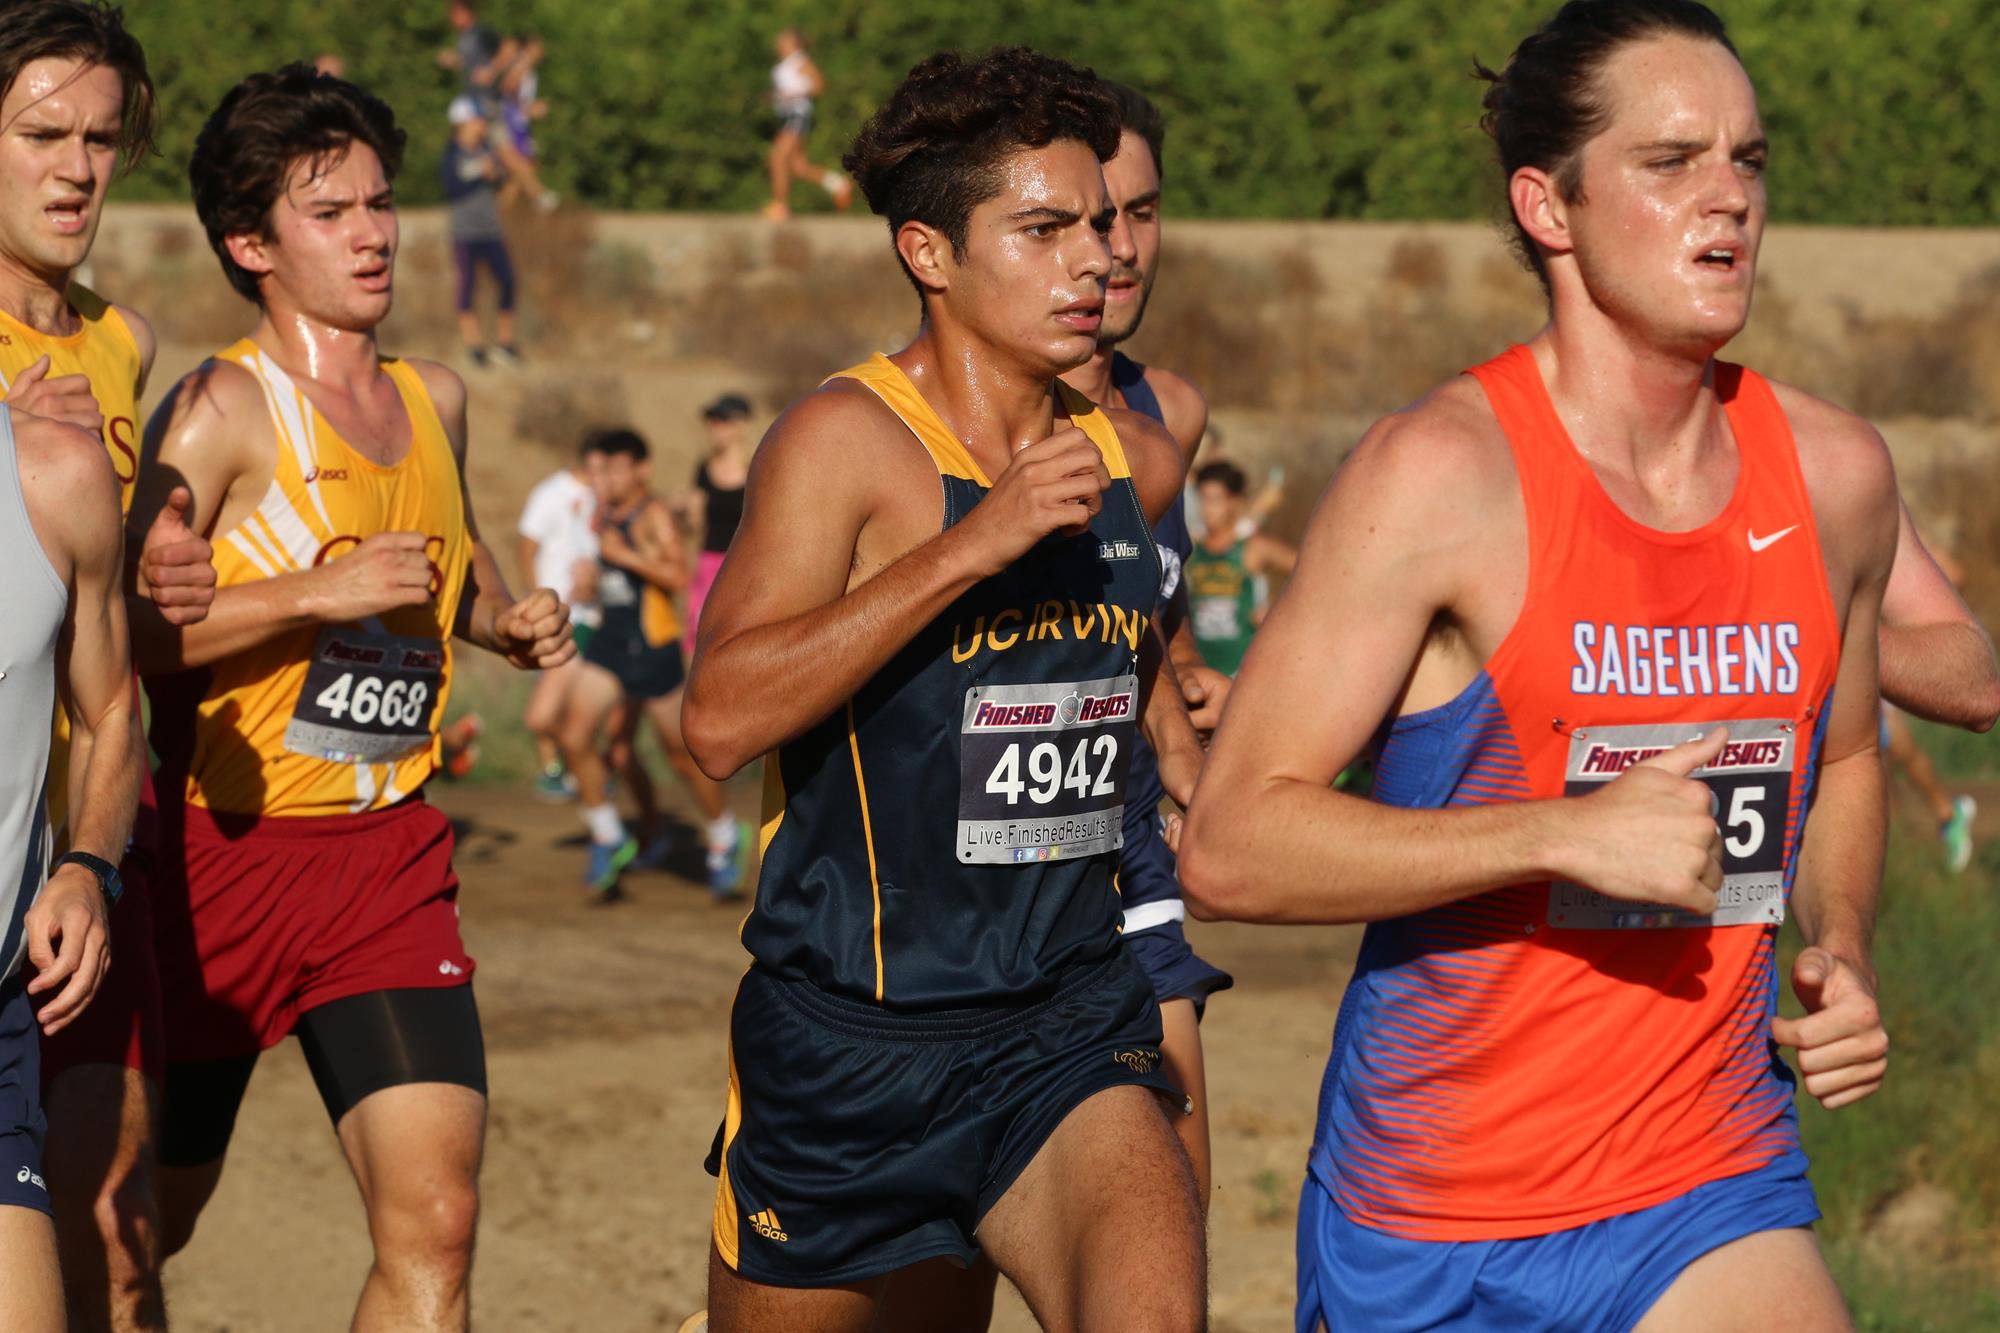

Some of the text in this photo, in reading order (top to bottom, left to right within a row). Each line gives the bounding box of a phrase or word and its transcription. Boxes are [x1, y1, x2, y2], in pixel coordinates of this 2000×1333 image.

[320, 469, 348, 481] asics
[1099, 543, 1138, 559] BIG WEST
[952, 608, 1023, 664] UC
[1571, 622, 1800, 696] SAGEHENS
[315, 672, 428, 728] 4668
[972, 694, 1132, 727] FINISHED RESULTS
[985, 733, 1119, 806] 4942
